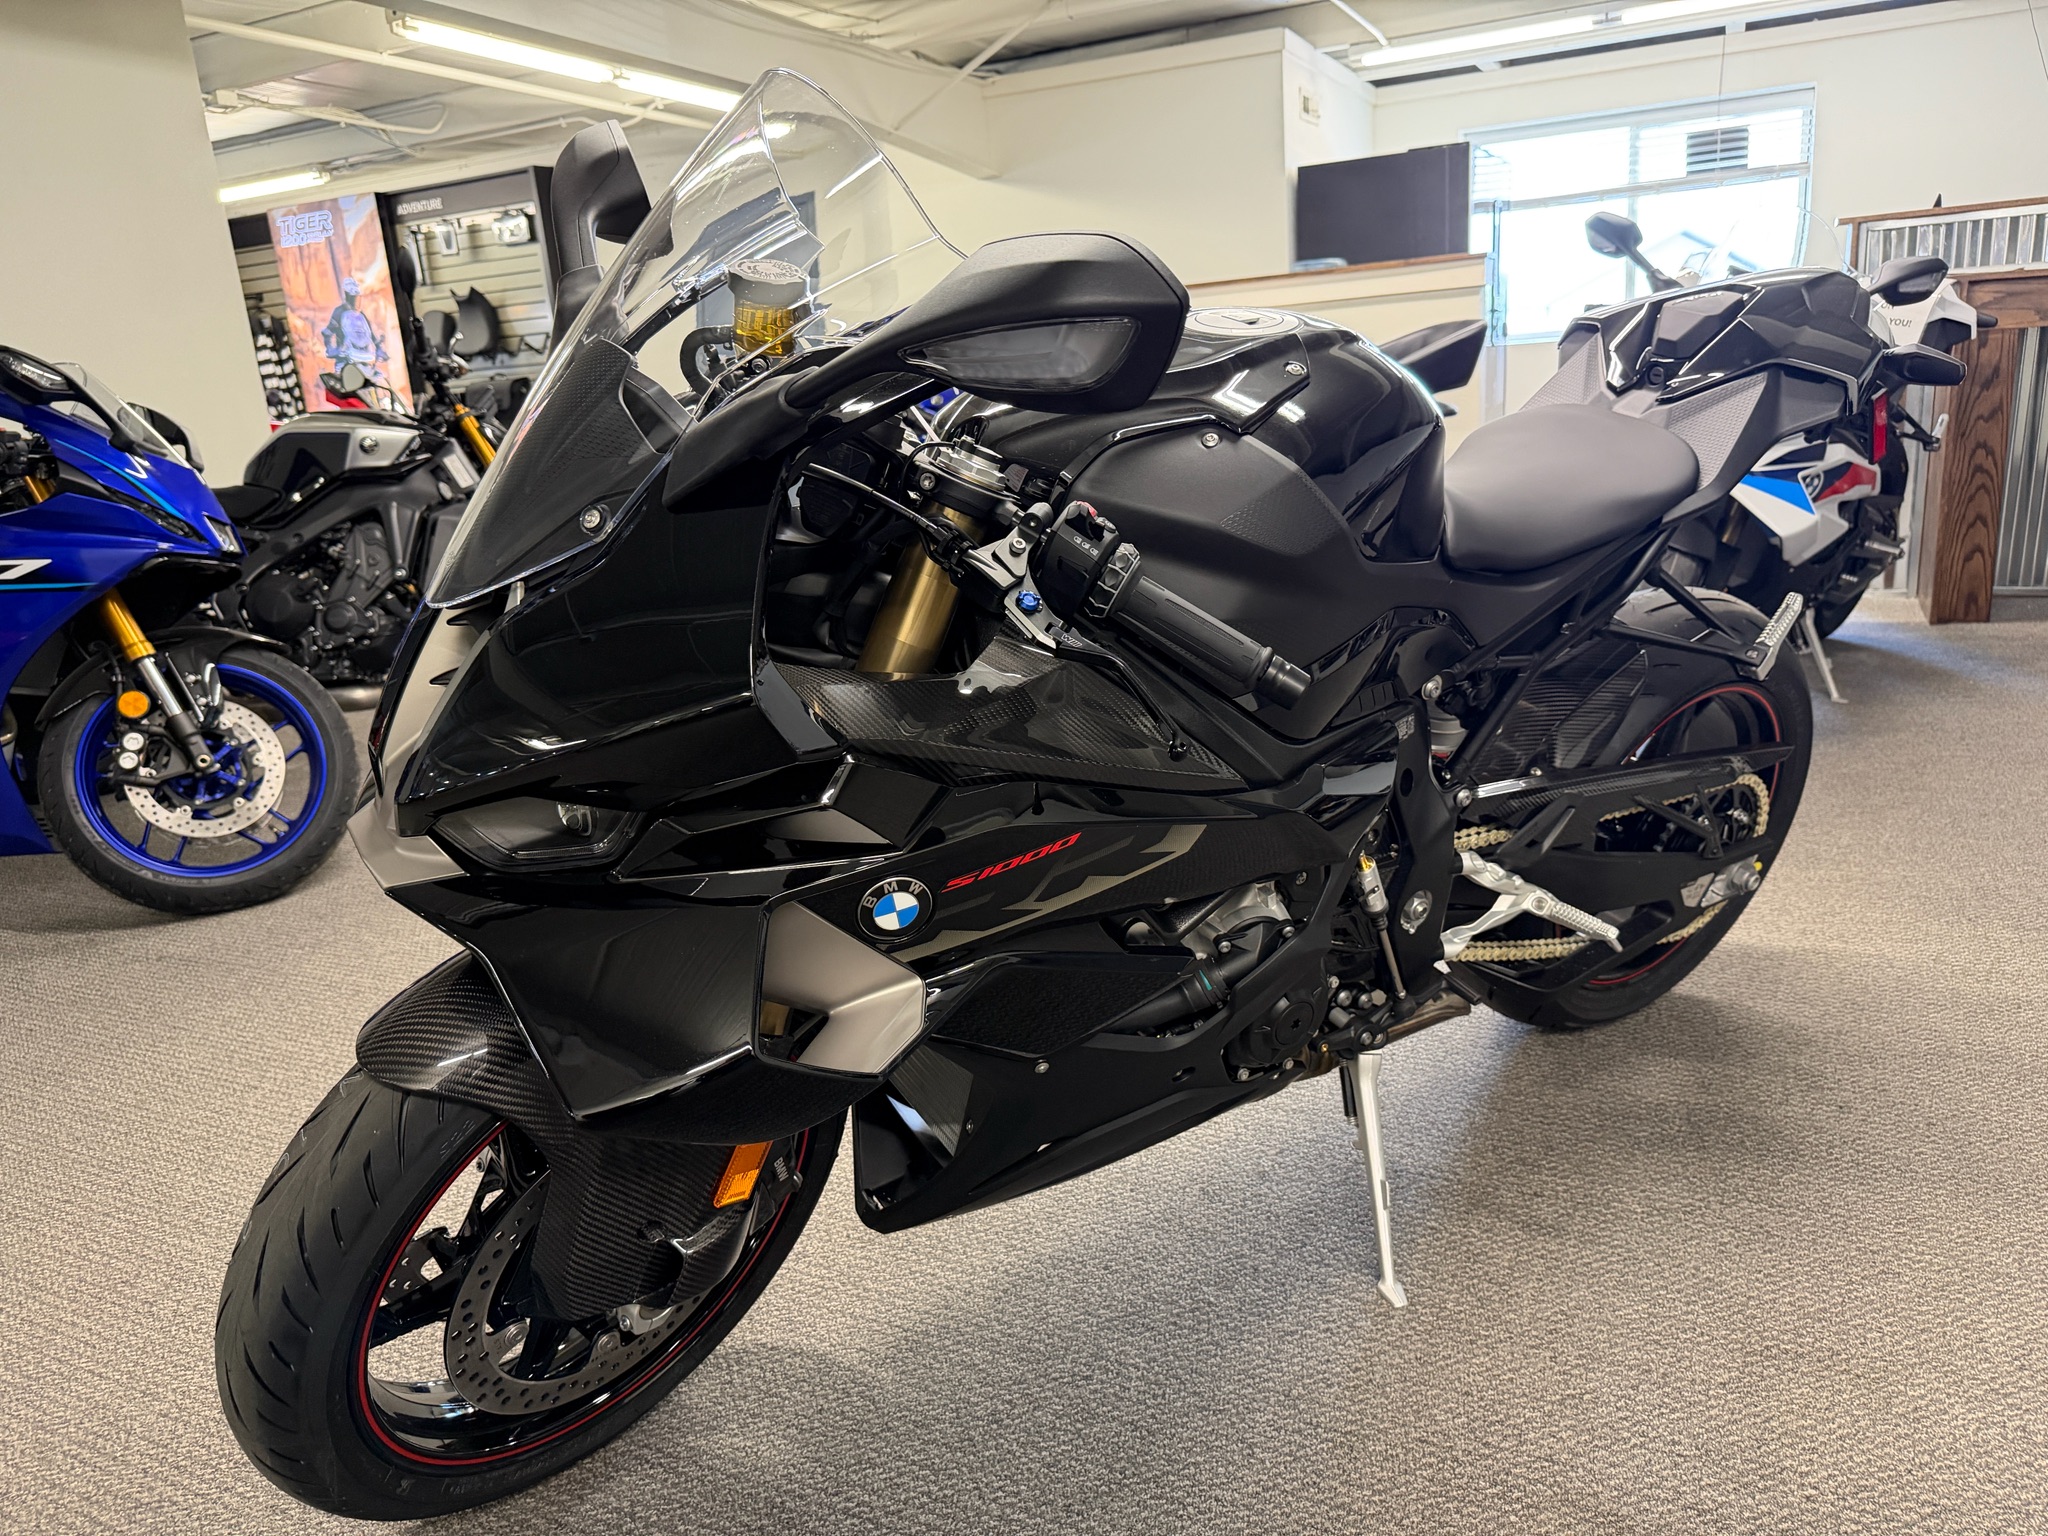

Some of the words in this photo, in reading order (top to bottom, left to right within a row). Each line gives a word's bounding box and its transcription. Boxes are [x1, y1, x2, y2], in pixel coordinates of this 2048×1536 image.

[397, 198, 443, 216] ADVENTURE
[277, 211, 334, 237] TIGER
[1889, 318, 1912, 328] YOU!
[941, 832, 1082, 893] S1000
[774, 1157, 789, 1182] BMW
